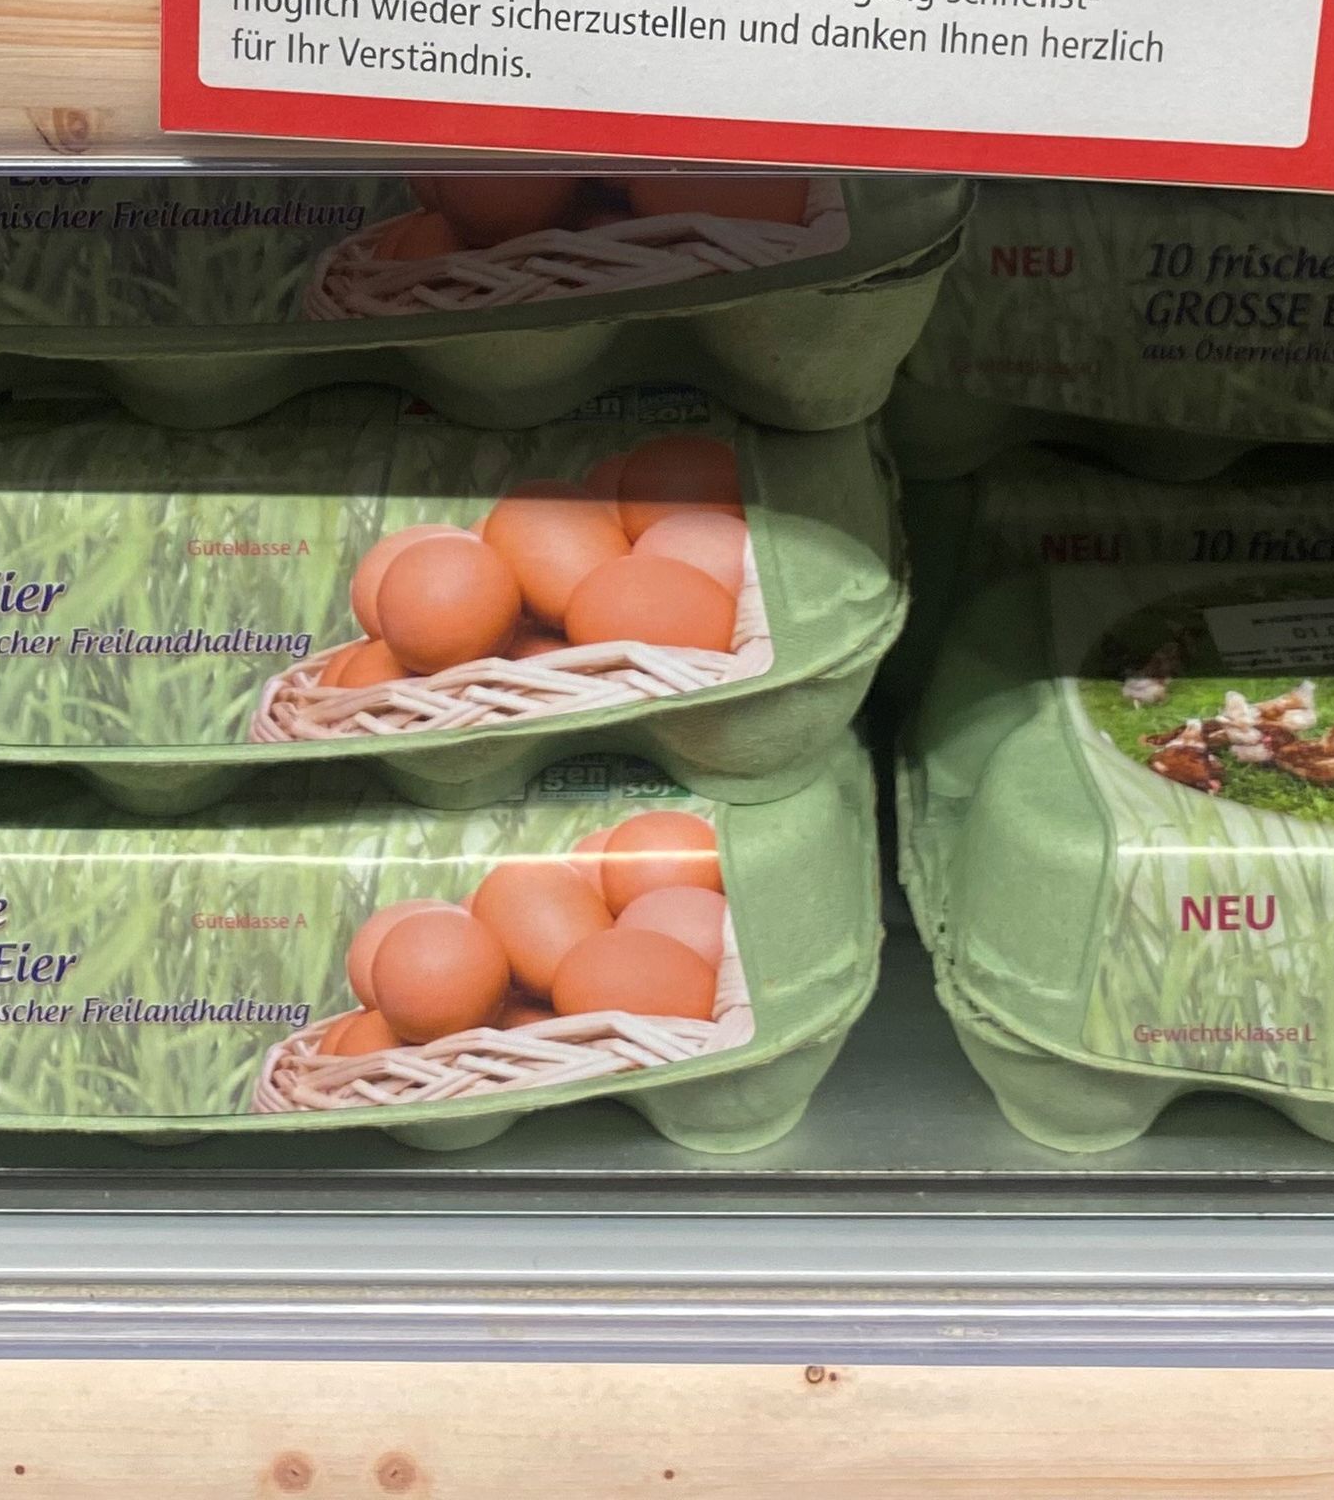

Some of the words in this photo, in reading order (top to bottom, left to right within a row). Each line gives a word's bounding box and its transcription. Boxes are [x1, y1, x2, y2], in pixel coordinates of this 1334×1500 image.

[232, 28, 275, 62] für
[288, 33, 329, 65] Ihr
[339, 36, 533, 79] Verständnis.
[739, 12, 800, 46] und
[811, 15, 926, 53] danken
[941, 21, 1028, 57] Ihnen
[1041, 25, 1164, 63] herzlich
[112, 201, 366, 235] Freilandhaltung
[69, 626, 313, 663] Freilandhaltung
[1180, 895, 1277, 932] NEU
[81, 995, 311, 1031] Freilandhaltung
[1133, 1023, 1298, 1047] Gewichtsklasse
